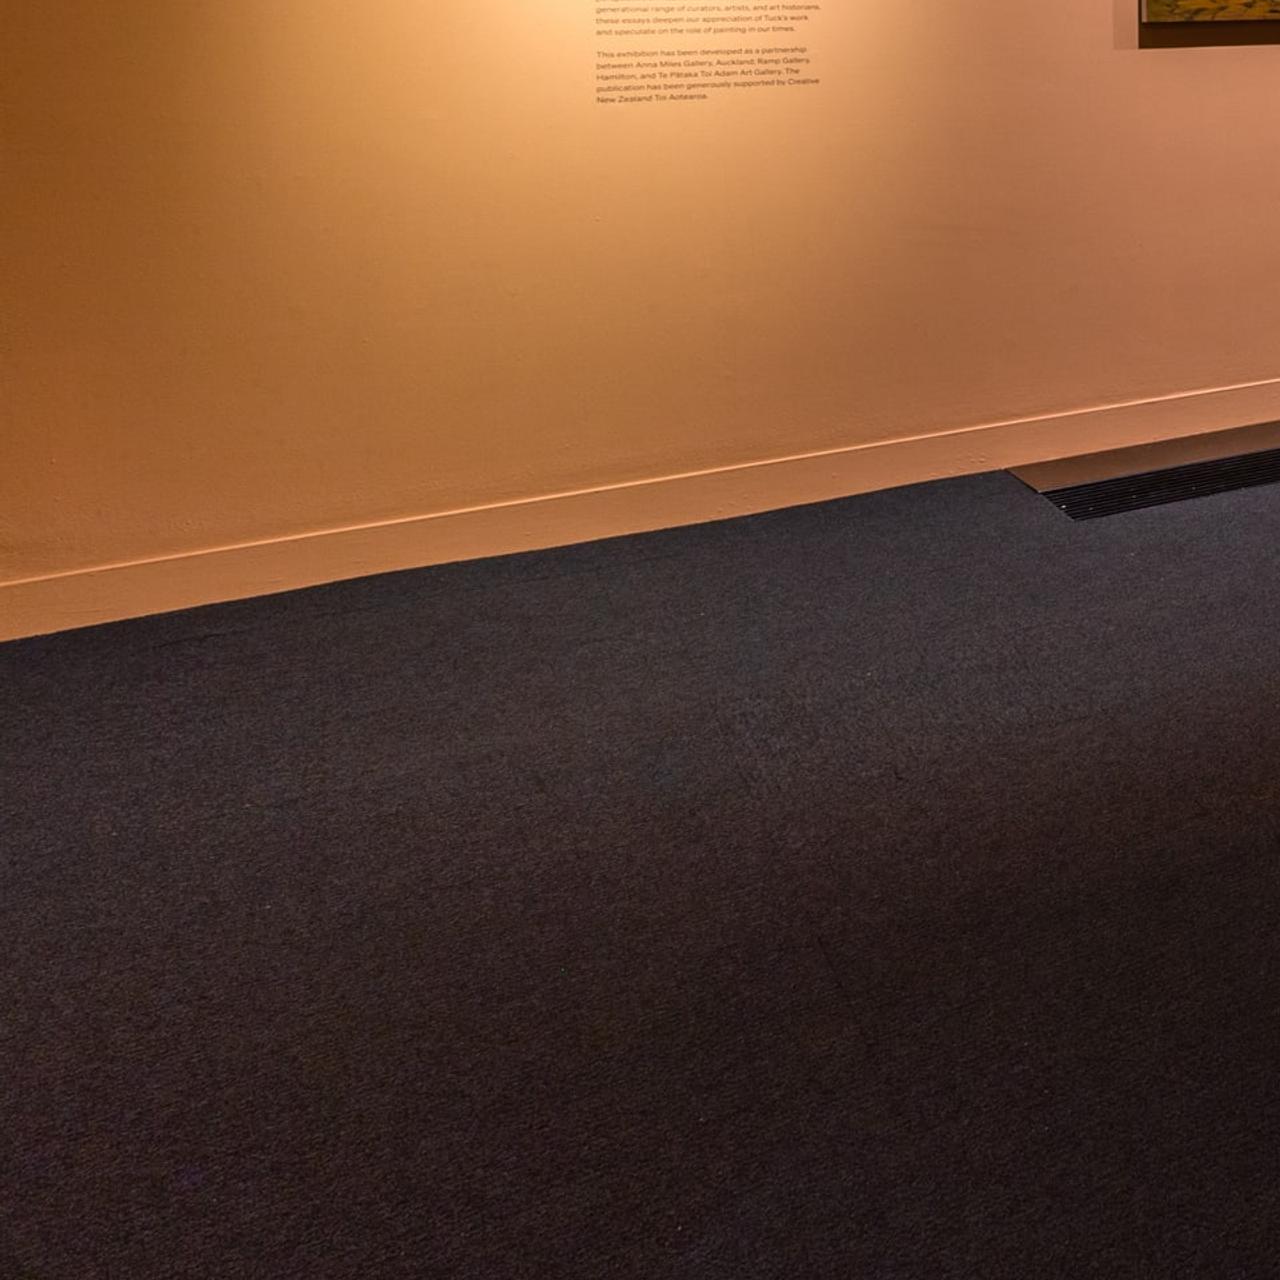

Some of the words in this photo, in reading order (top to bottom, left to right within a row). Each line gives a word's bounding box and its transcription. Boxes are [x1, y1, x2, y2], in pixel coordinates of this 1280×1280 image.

[699, 47, 742, 57] developed
[595, 61, 633, 69] between
[757, 57, 780, 67] Ramp
[733, 78, 775, 89] supported
[787, 77, 819, 85] Creative
[618, 94, 652, 102] Zealand
